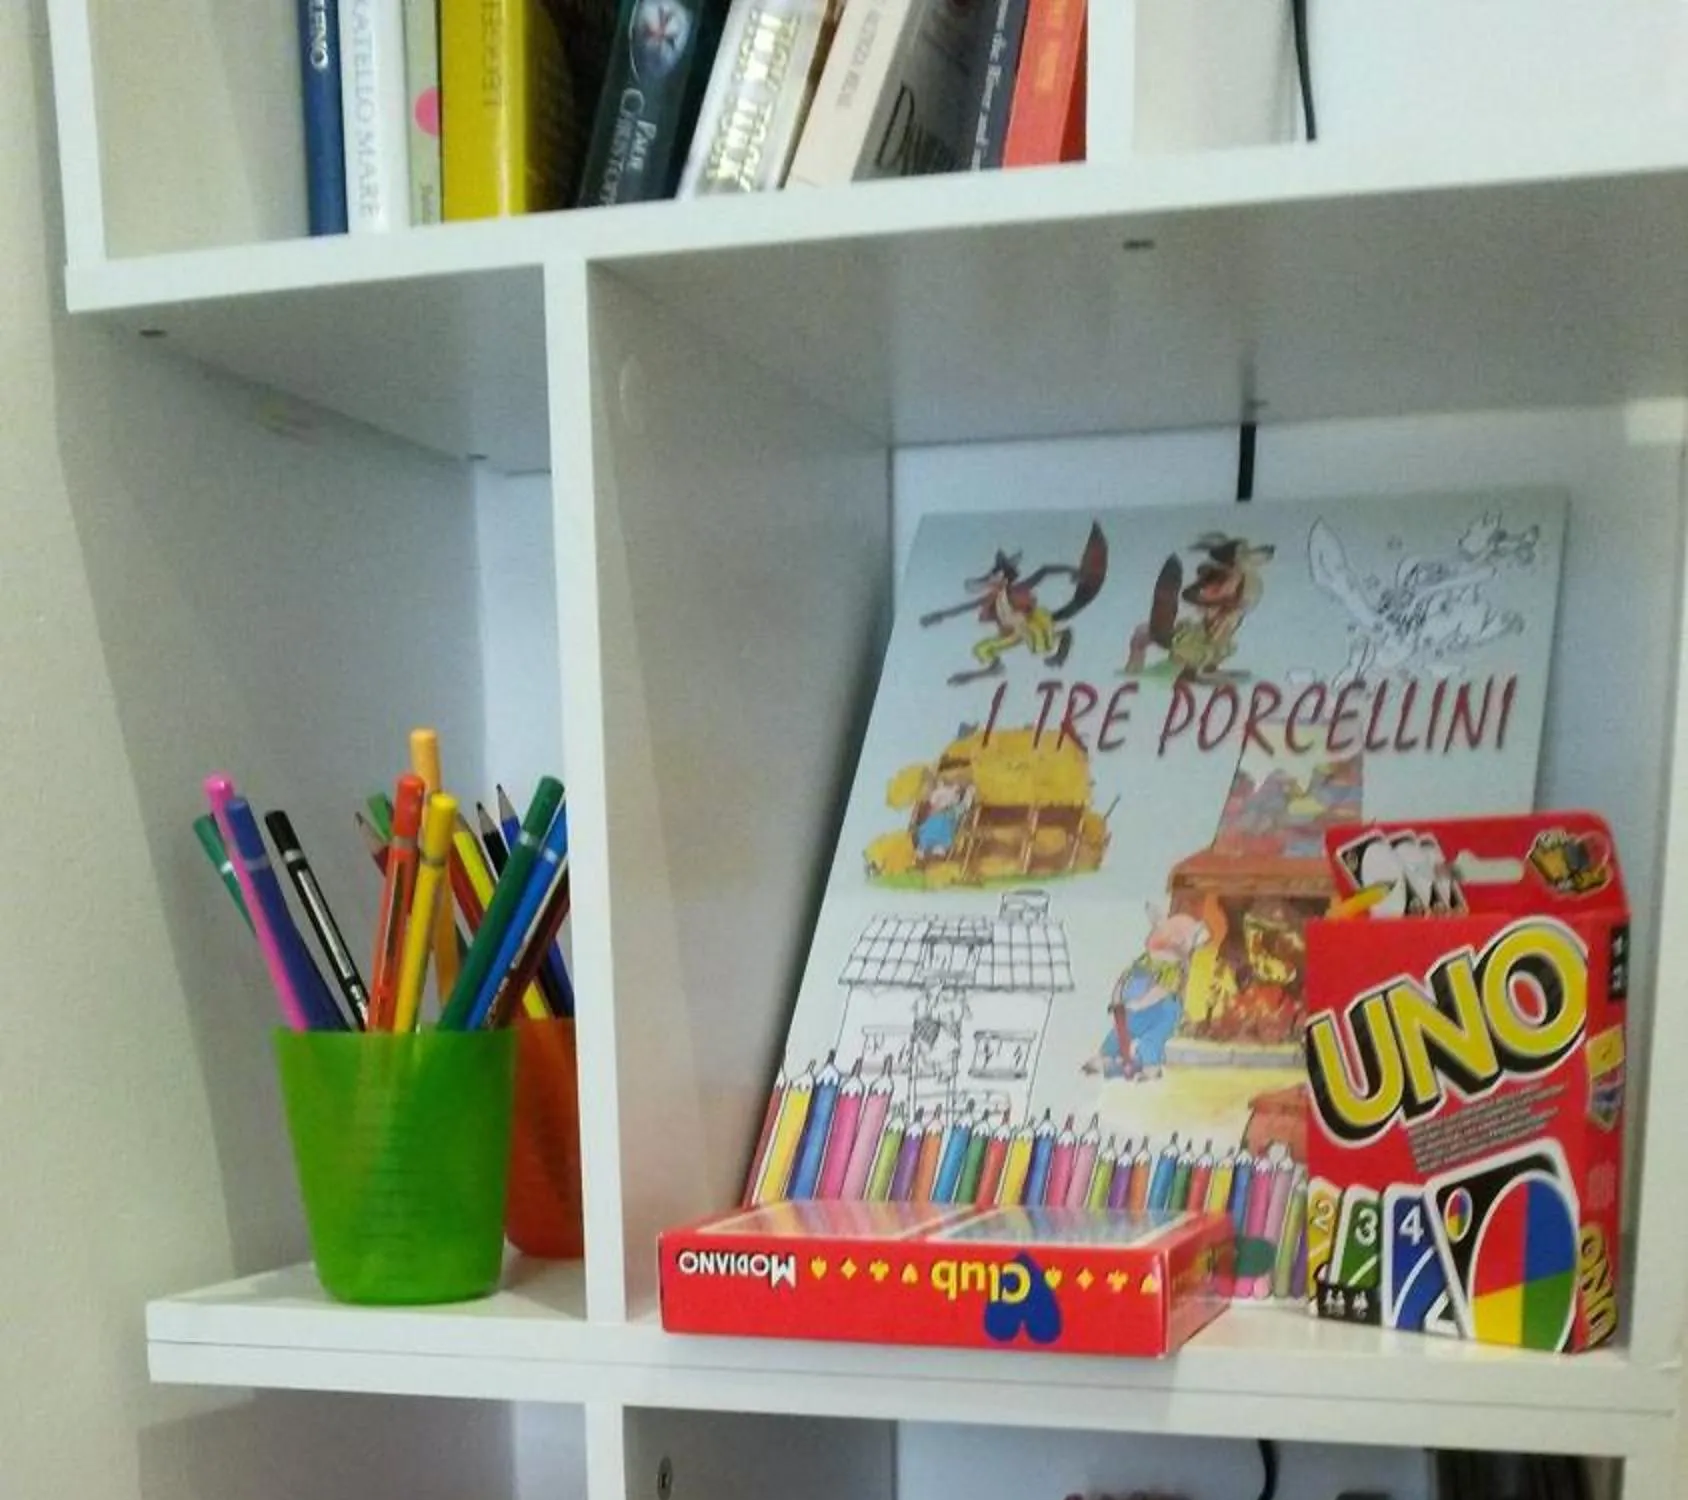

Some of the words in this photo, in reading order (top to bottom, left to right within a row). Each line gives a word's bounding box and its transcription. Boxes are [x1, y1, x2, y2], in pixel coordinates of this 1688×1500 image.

[981, 680, 1006, 750] I
[1027, 680, 1139, 754] TRE
[1156, 674, 1519, 758] PORCELLINI
[1306, 918, 1588, 1146] UNO
[1355, 1208, 1379, 1246] 3
[1399, 1205, 1425, 1246] 4
[678, 1249, 797, 1289] MODIANO
[930, 1258, 1031, 1306] Club
